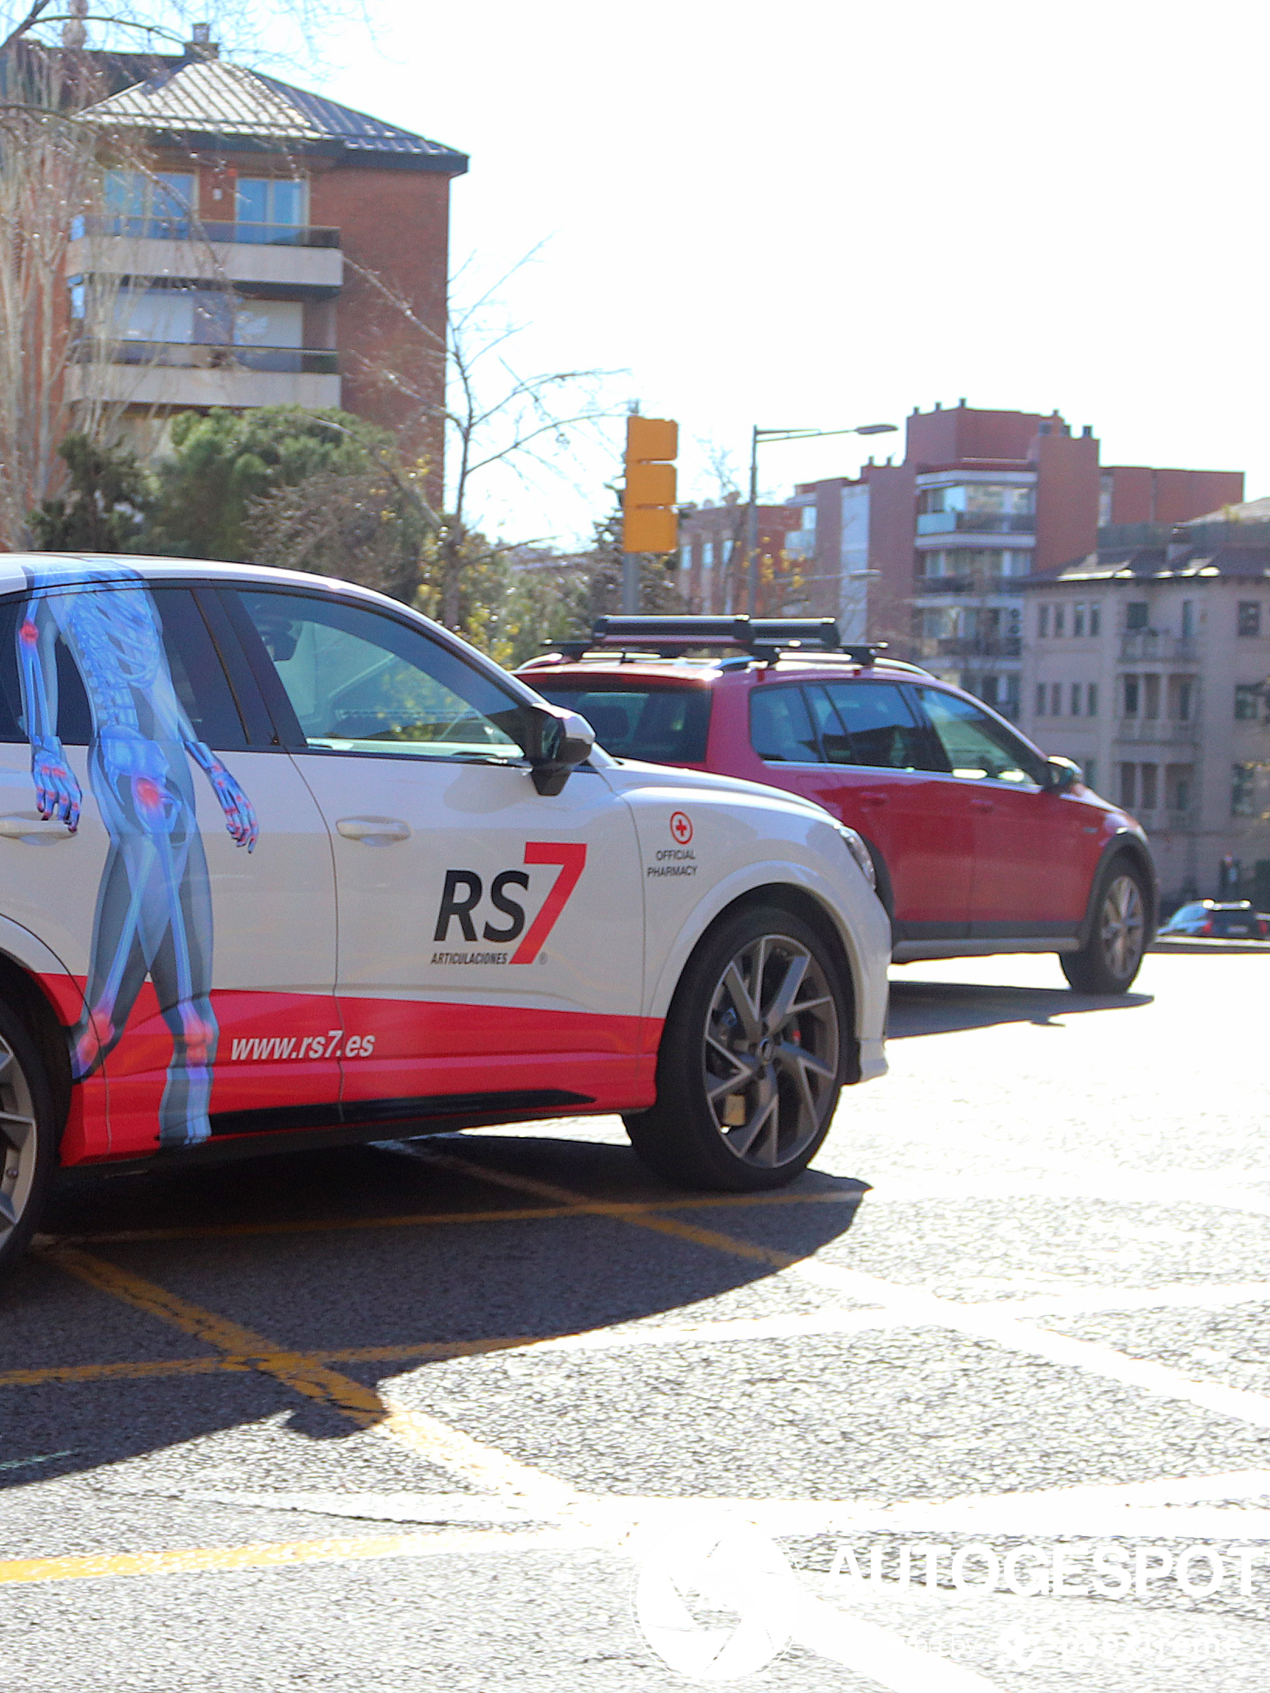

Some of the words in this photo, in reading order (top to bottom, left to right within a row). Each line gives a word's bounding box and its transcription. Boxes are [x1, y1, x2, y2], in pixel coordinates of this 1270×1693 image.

[656, 849, 696, 861] OFFICIAL
[647, 865, 698, 877] PHARMACY
[433, 841, 588, 965] RS7
[430, 953, 508, 965] ARTICULACIONES
[231, 1030, 376, 1061] www.rs7.es
